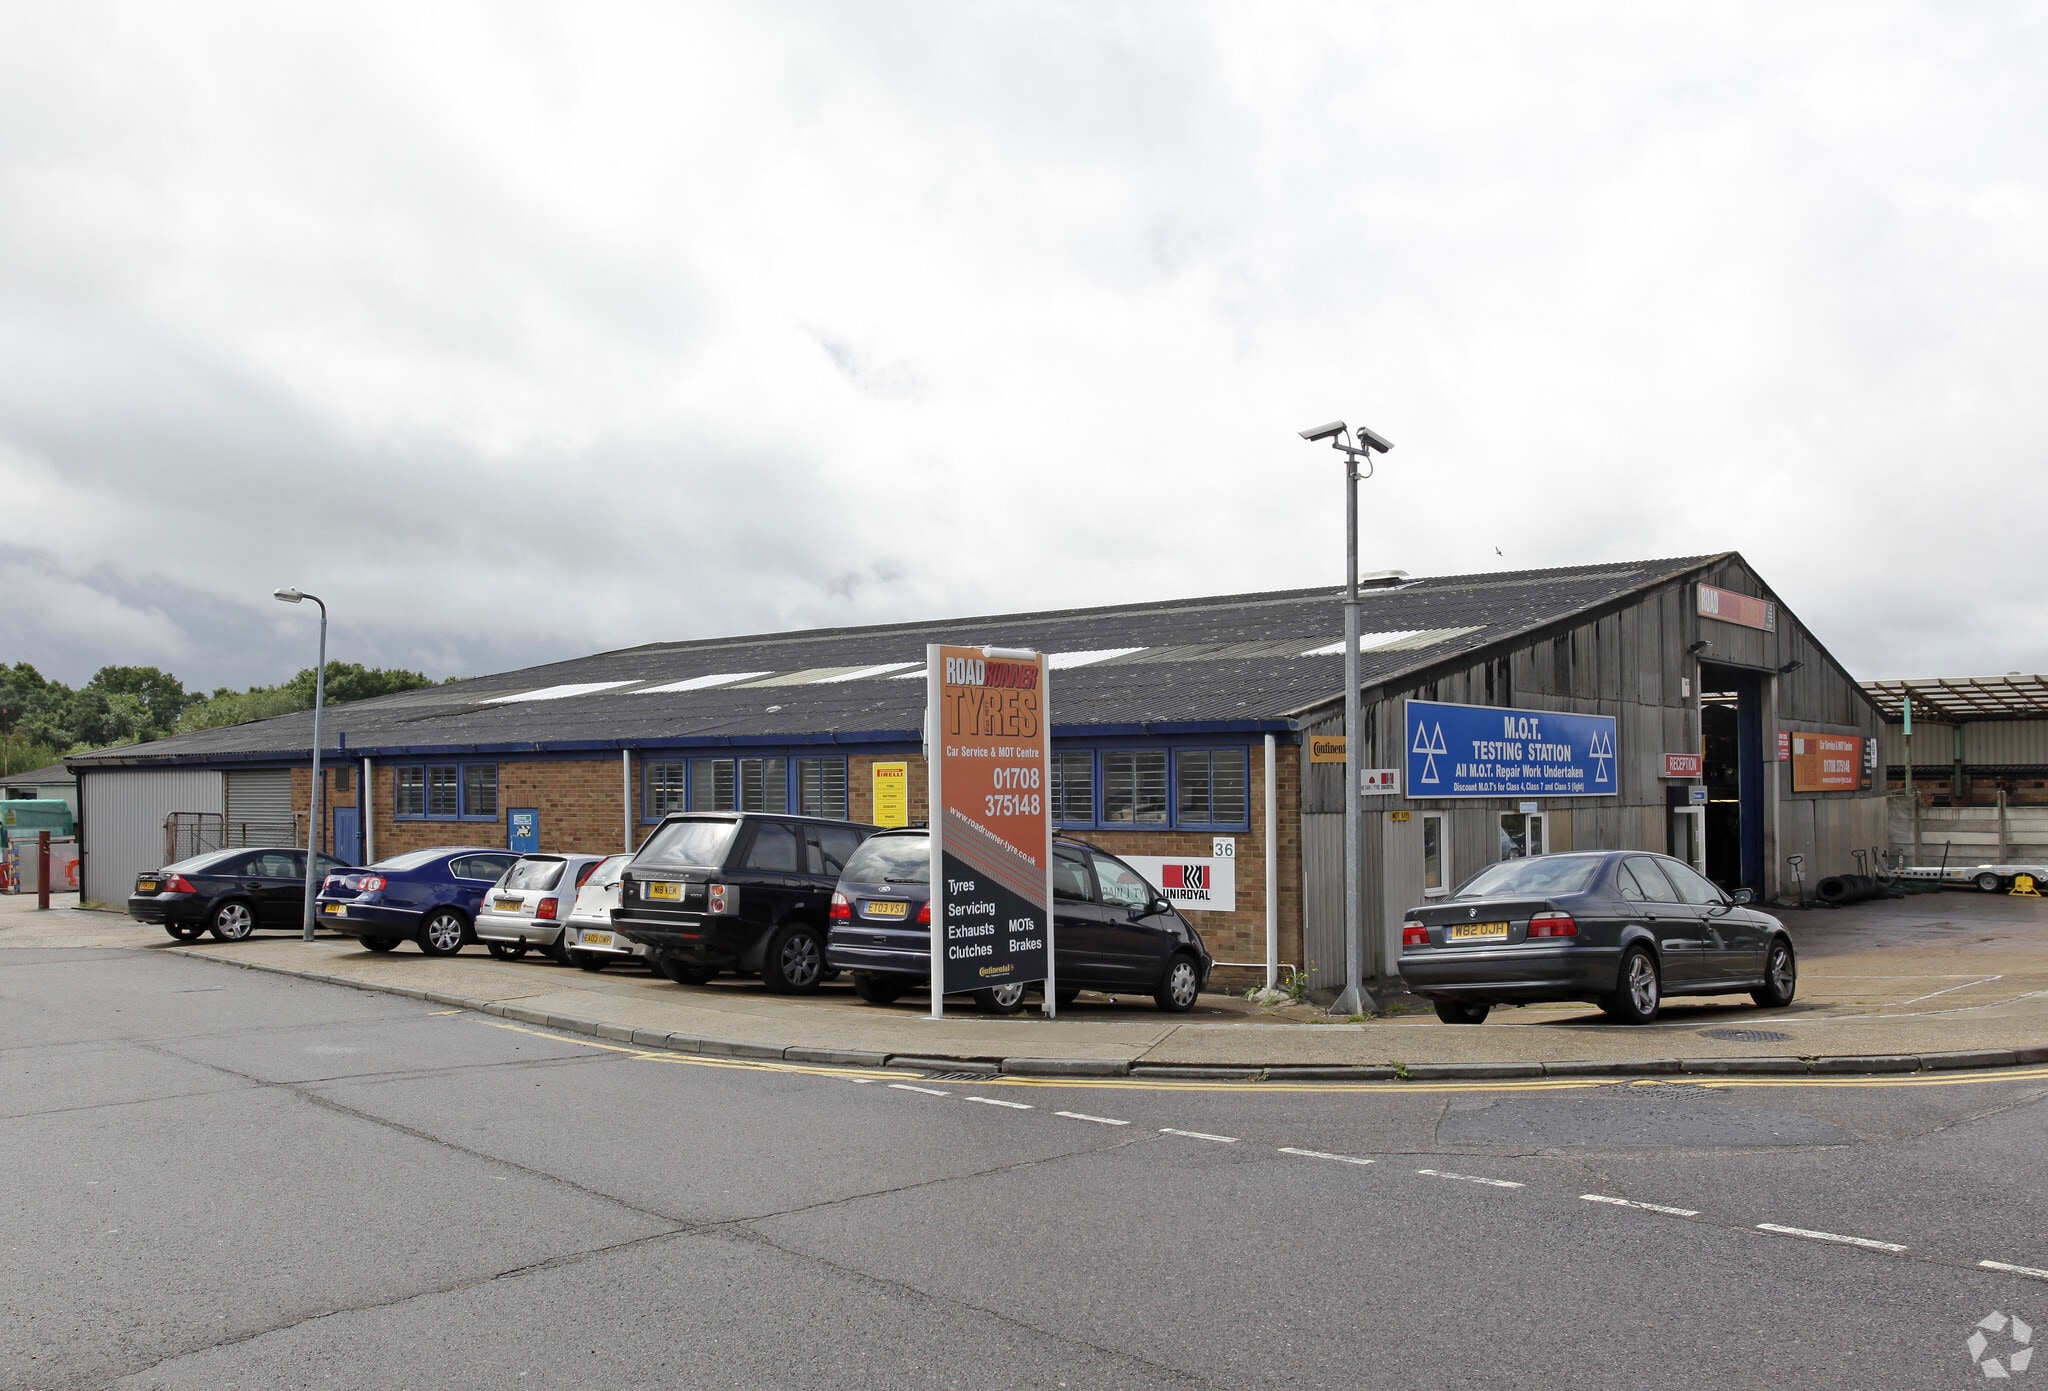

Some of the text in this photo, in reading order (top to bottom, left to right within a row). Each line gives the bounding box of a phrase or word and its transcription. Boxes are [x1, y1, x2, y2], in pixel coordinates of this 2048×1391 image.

[945, 686, 1037, 738] TYRES
[1504, 716, 1541, 740] M.O.T.
[946, 745, 1039, 758] Car Service & MOT Centre
[1472, 741, 1571, 761] TESTING STATION
[1455, 763, 1583, 780] All M.O.T. Repair Work Undertaken
[1670, 757, 1697, 770] RECEPTION
[877, 768, 903, 777] PIRELLI
[993, 768, 1040, 789] 01708
[1453, 782, 1477, 791] Discount
[1506, 782, 1520, 791] Class
[1526, 782, 1539, 791] Class
[1540, 782, 1543, 790] 7
[1545, 782, 1553, 790] and
[1554, 782, 1566, 790] Class
[1567, 782, 1571, 790] 5
[985, 794, 1040, 816] 375148
[950, 806, 1036, 866] www.roadrunner-tyre.co.uk
[1215, 843, 1233, 856] 36
[948, 879, 975, 895] Tyres
[1163, 889, 1211, 900] UNIROYAL
[868, 902, 904, 913] ET03 VSA
[948, 901, 996, 917] Servicing
[948, 923, 995, 939] Exhausts
[1009, 917, 1034, 933] MOTs
[1455, 922, 1504, 937] W82 OJH
[949, 944, 993, 960] Clutches
[1009, 938, 1042, 952] Brakes
[979, 963, 1010, 977] Continental
